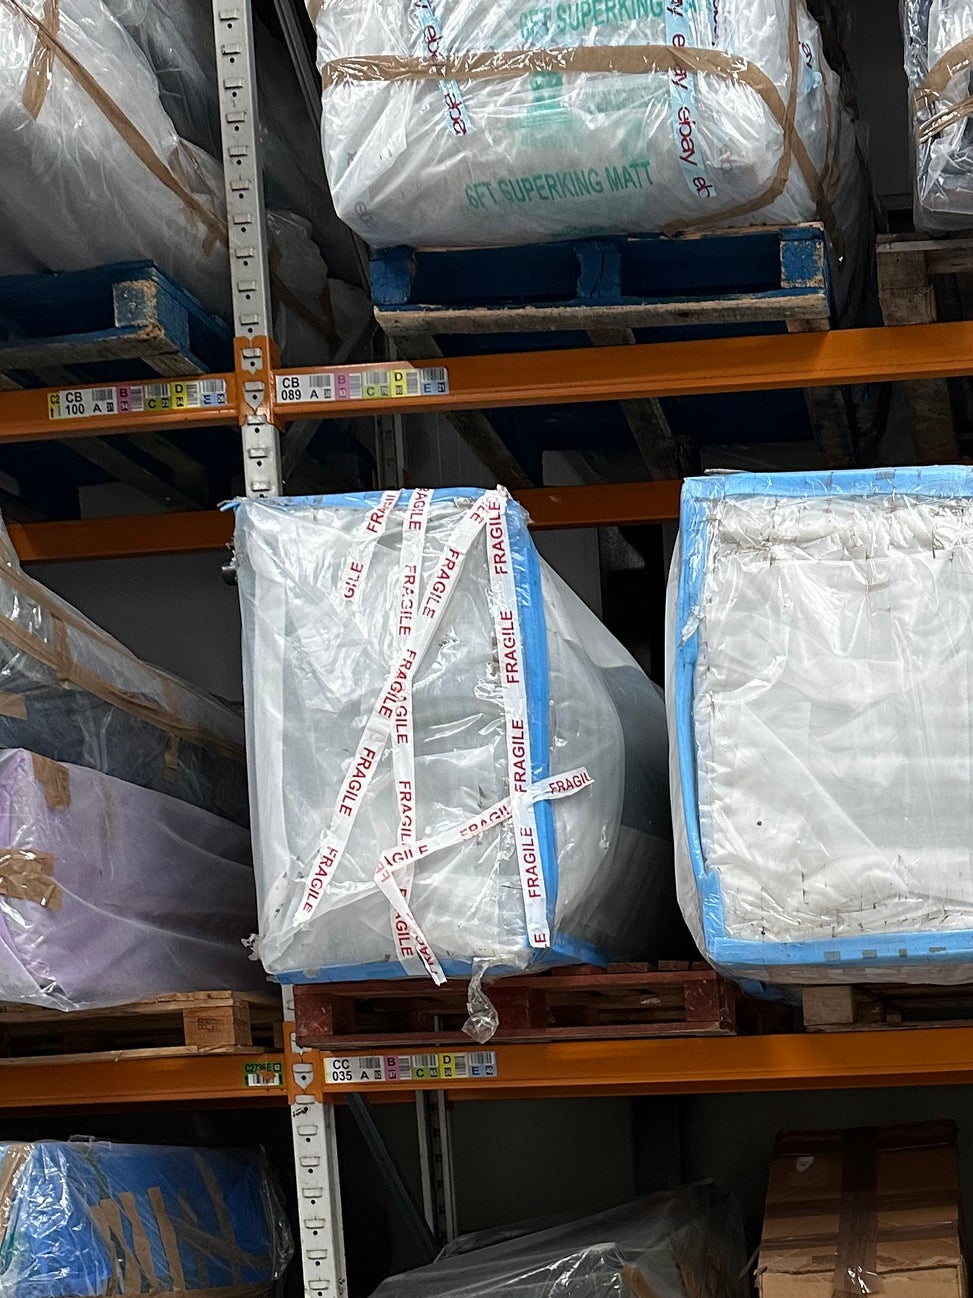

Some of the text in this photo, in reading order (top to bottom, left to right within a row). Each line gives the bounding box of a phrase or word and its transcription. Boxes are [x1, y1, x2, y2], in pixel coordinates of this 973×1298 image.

[677, 106, 698, 166] ebay
[465, 160, 654, 210] 6FT SUPERKING MATT
[282, 377, 299, 388] CB
[338, 375, 346, 385] B
[394, 372, 403, 382] D
[119, 388, 128, 398] B
[175, 384, 183, 394] D
[366, 386, 375, 396] C
[424, 384, 431, 393] E
[66, 392, 83, 403] CB
[281, 389, 301, 401] 089
[310, 390, 319, 399] A
[65, 403, 85, 415] 100
[93, 403, 102, 413] A
[147, 398, 156, 409] C
[489, 501, 519, 684] FRAGILE FRAGILE
[399, 565, 417, 636] FRAGILE
[302, 548, 460, 913] FRAGILE FRAGILE FRAGILE FRAGILE
[511, 719, 541, 899] FRAGILE FRAGILE
[332, 1060, 350, 1070] CC
[387, 1057, 396, 1066] B
[443, 1055, 451, 1064] D
[332, 1070, 352, 1082] 035
[360, 1071, 369, 1080] A
[416, 1068, 424, 1078] C
[472, 1066, 480, 1075] E
